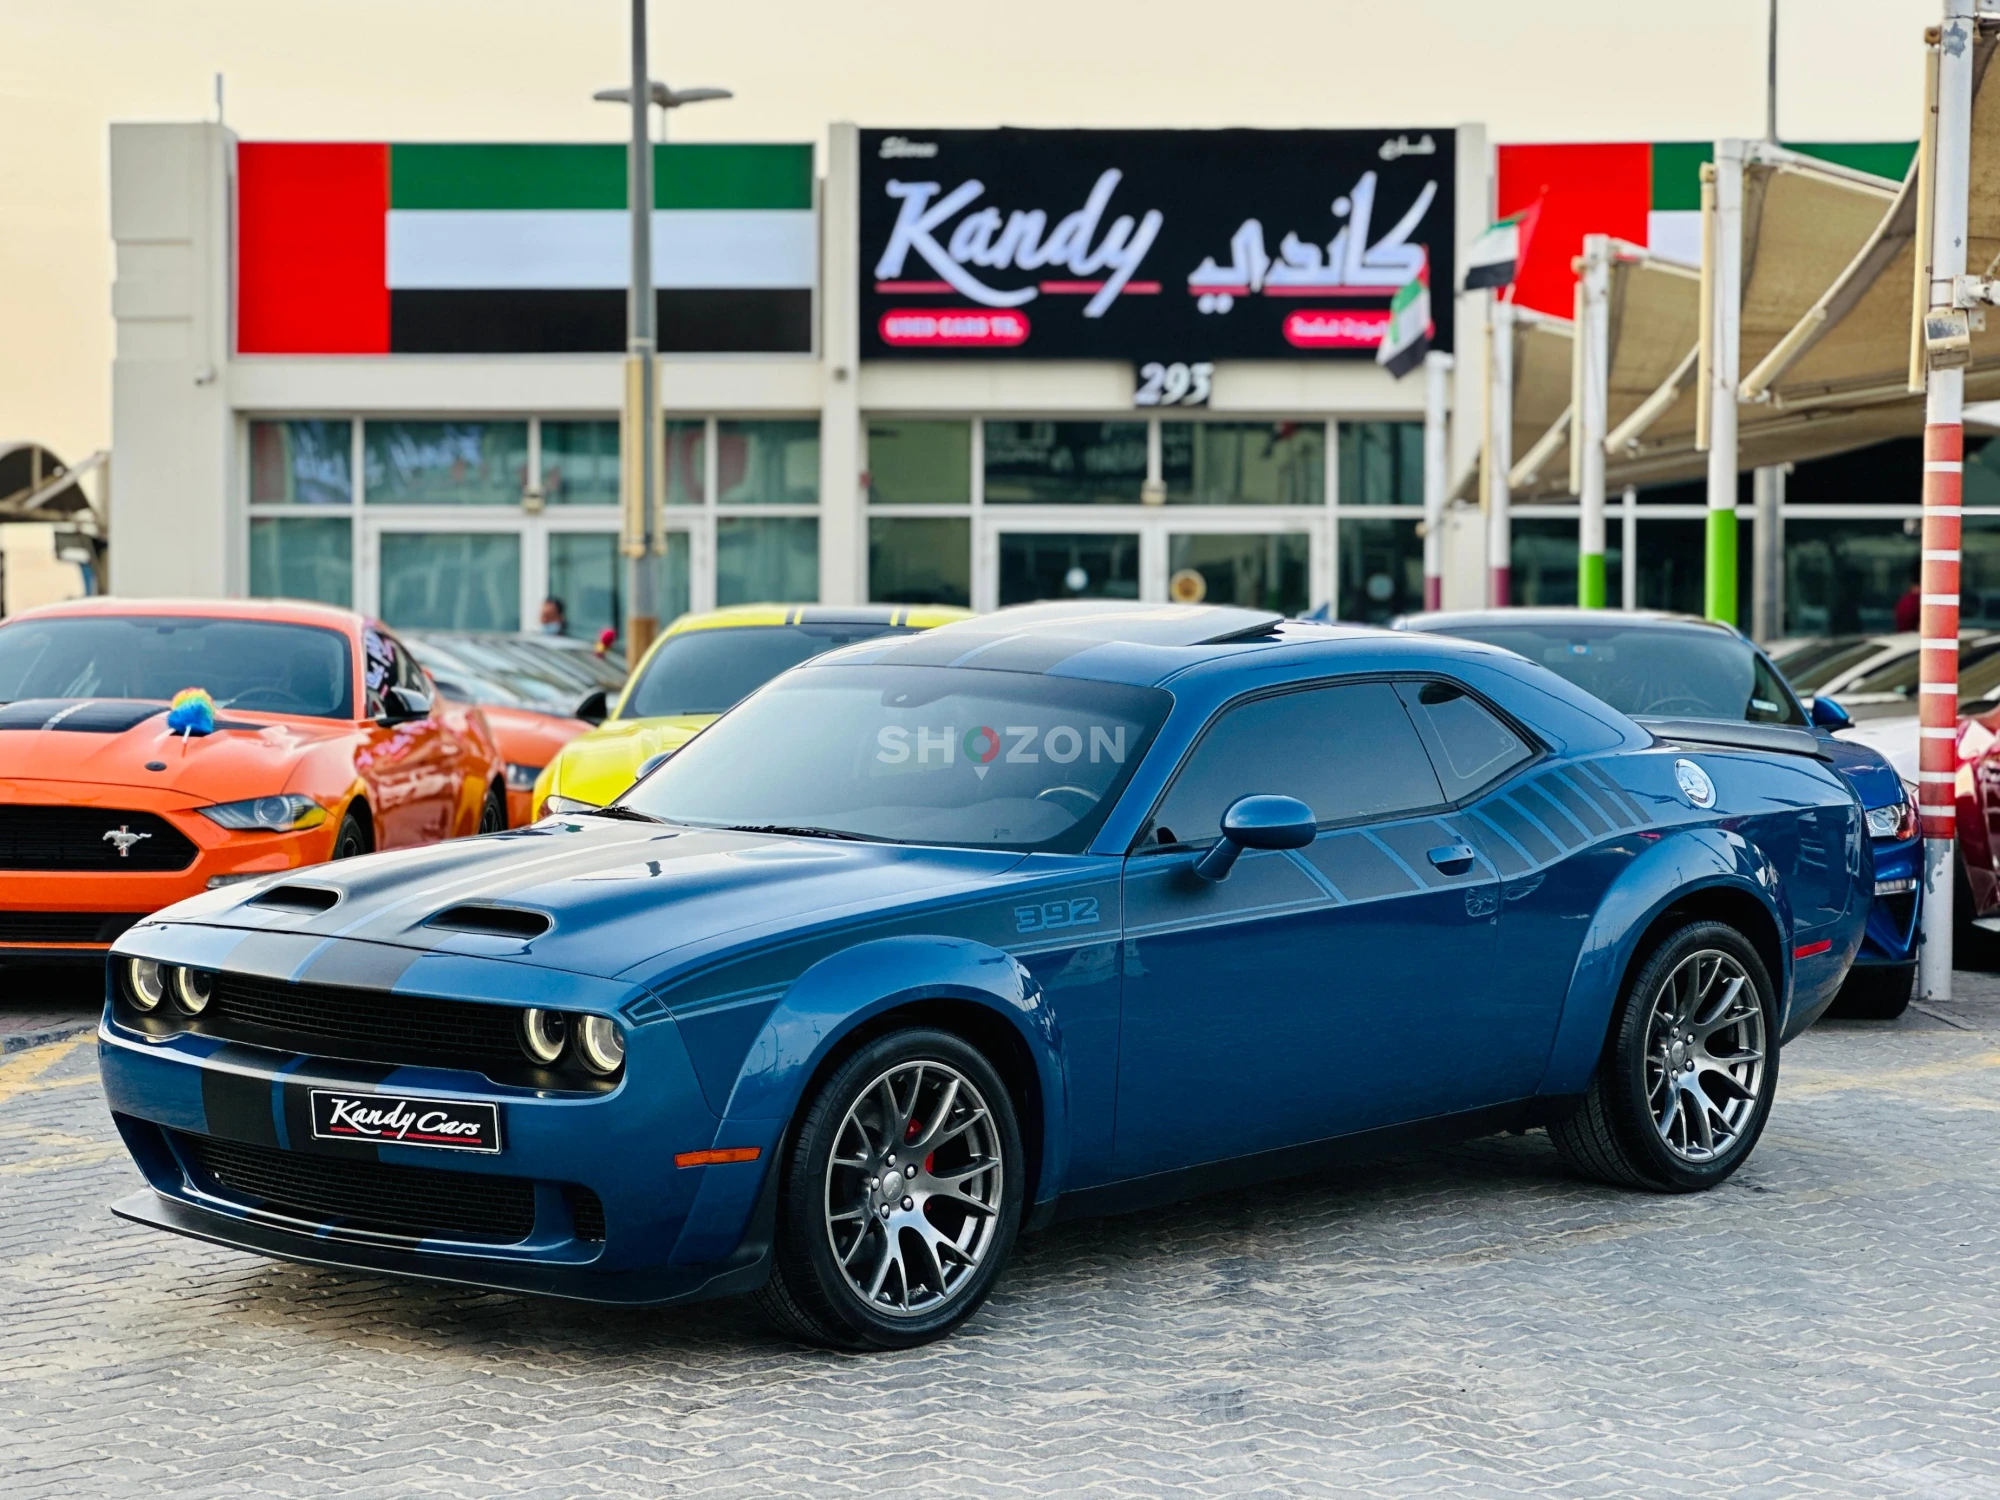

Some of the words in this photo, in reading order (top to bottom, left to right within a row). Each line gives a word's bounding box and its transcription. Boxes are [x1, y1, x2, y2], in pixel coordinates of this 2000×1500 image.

[874, 167, 1163, 317] Kandy
[1134, 361, 1214, 405] 295
[1014, 896, 1100, 932] 392
[331, 1098, 416, 1139] Kandy
[417, 1111, 481, 1136] Cars
